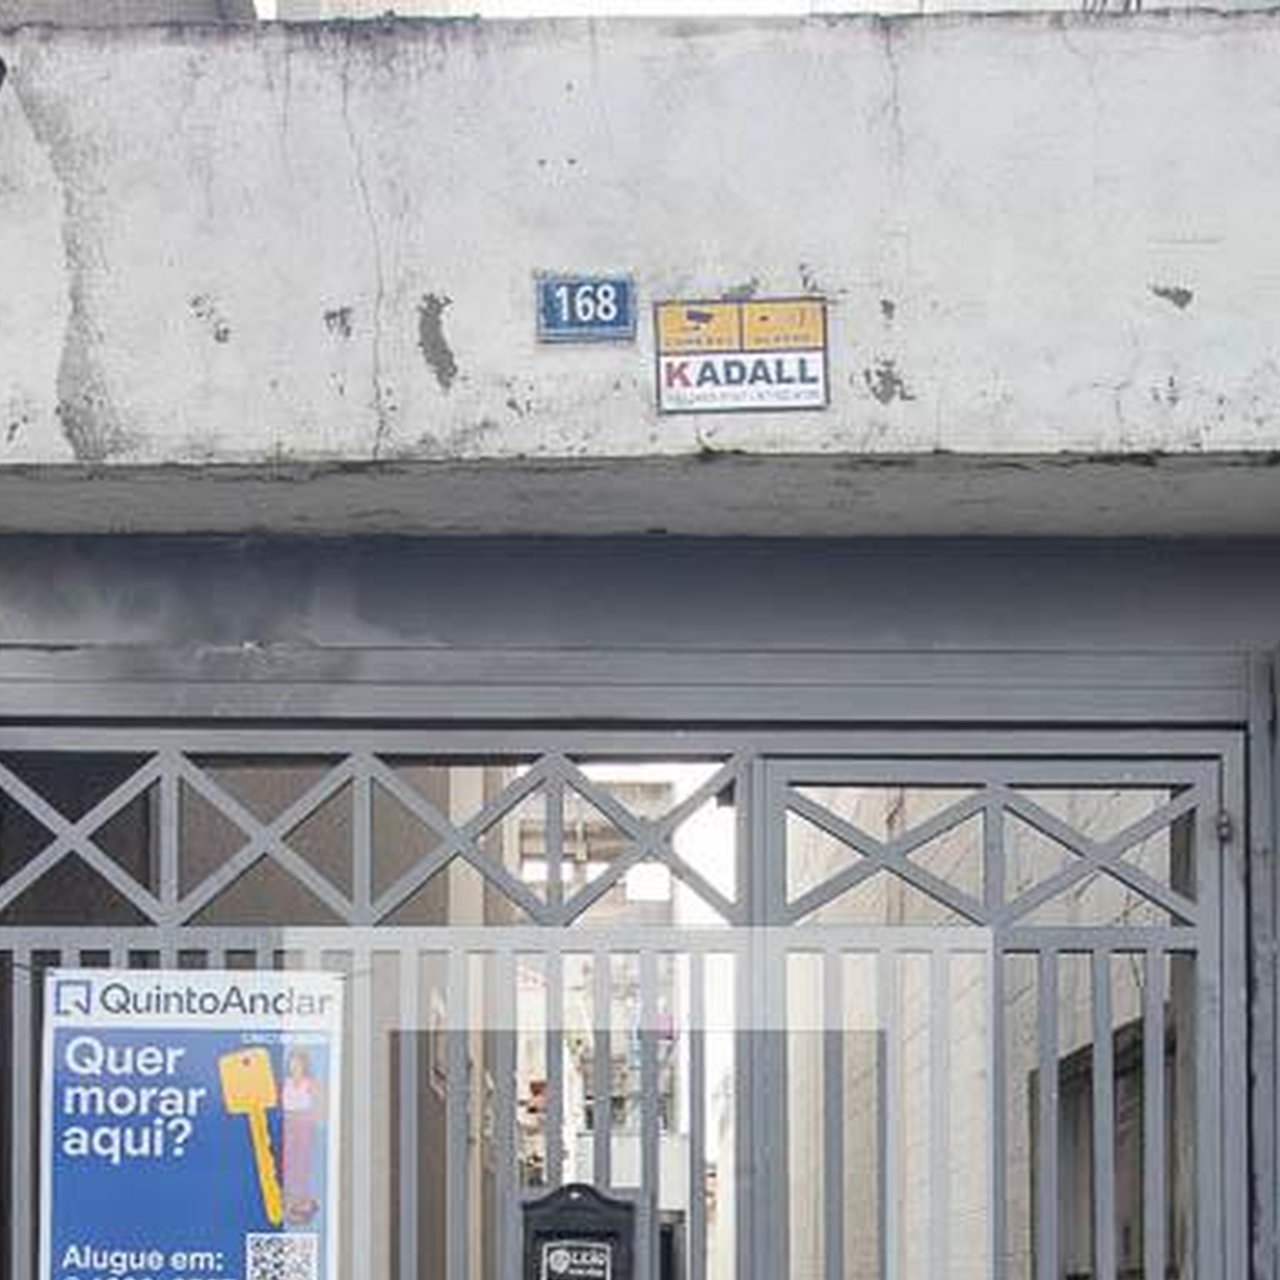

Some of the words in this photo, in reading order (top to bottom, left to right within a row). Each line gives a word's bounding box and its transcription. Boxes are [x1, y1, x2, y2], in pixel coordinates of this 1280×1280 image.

[555, 284, 617, 321] 168
[665, 358, 819, 388] KADALL
[100, 983, 331, 1015] QuintoAndar
[65, 1037, 185, 1075] Quer
[63, 1084, 206, 1116] morar
[62, 1117, 192, 1165] aqui?
[62, 1245, 164, 1274] Alugue
[170, 1251, 224, 1271] em:
